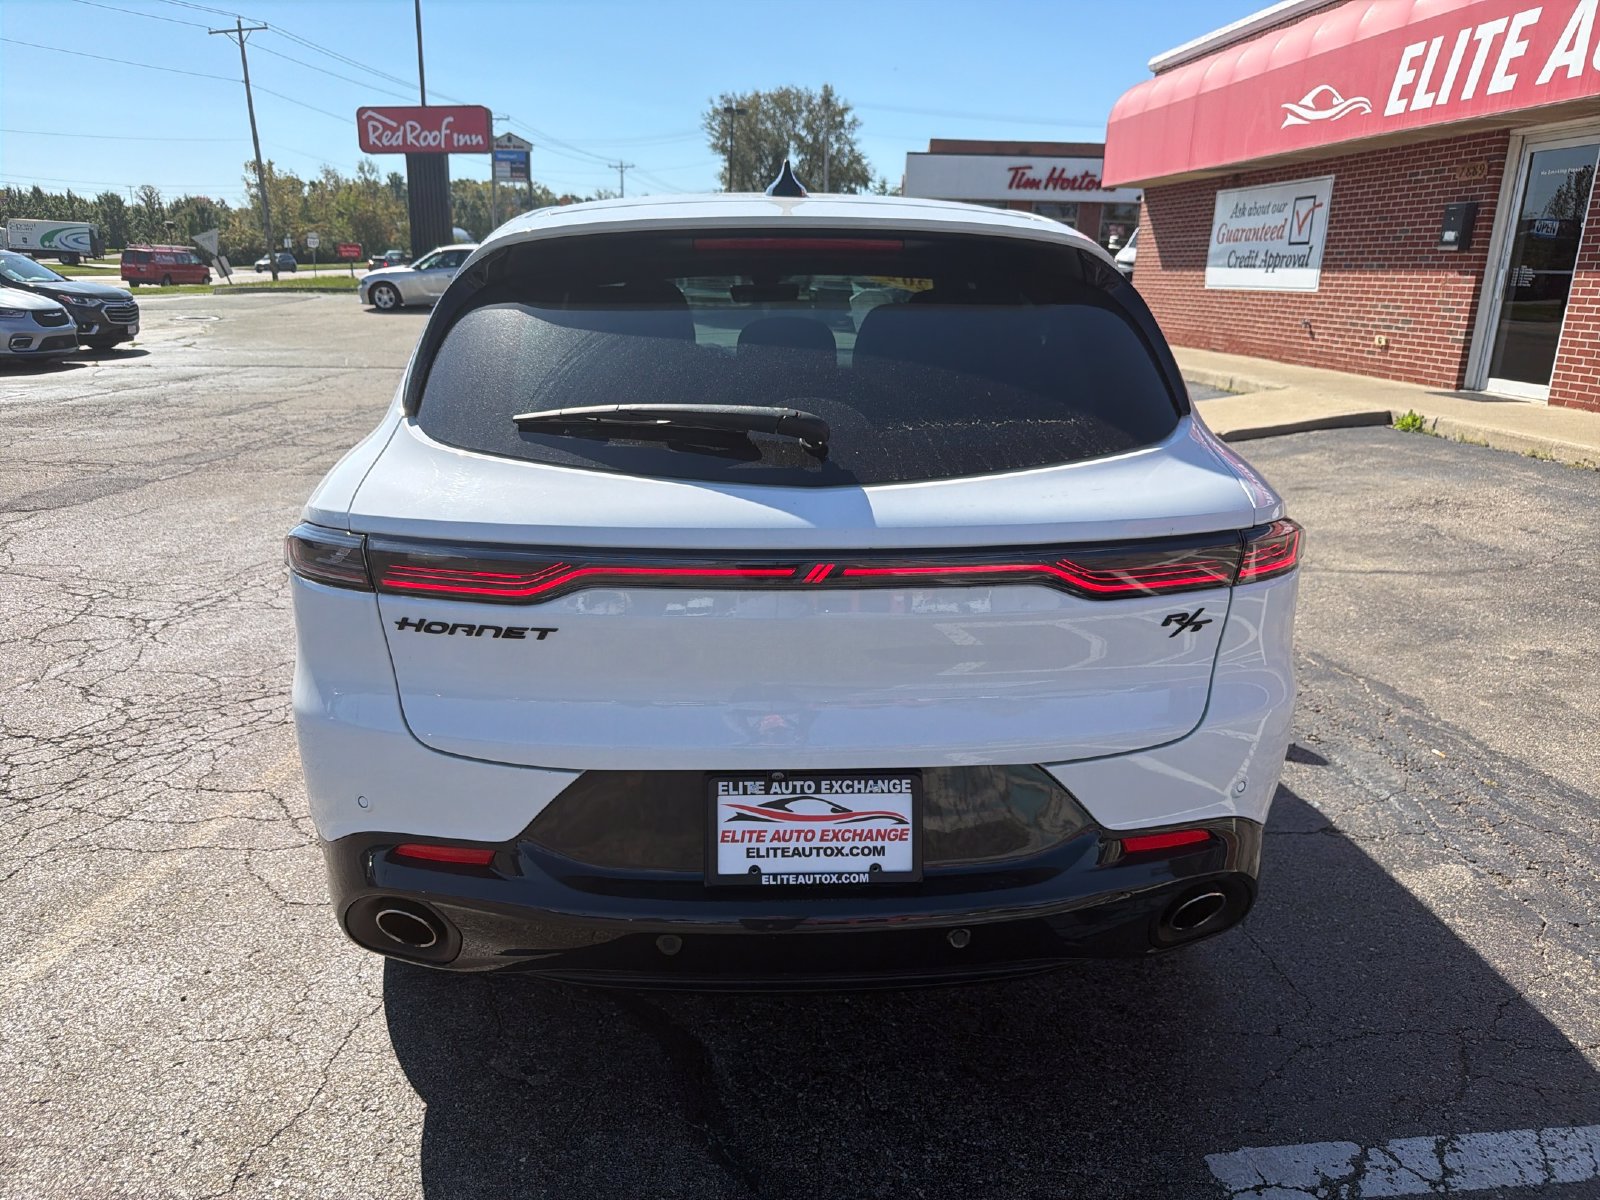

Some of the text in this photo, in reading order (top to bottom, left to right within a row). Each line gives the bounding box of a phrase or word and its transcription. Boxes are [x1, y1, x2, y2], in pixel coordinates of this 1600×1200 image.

[1383, 0, 1600, 117] ELITE A
[367, 119, 404, 147] Red
[405, 117, 454, 149] Roof
[1007, 165, 1042, 190] Tim
[1229, 200, 1288, 219] Ask about our
[1216, 218, 1288, 245] Guaranteed
[1536, 222, 1557, 234] OPEN
[1227, 245, 1314, 273] Credit Approval
[394, 616, 559, 641] HORNET
[1160, 607, 1213, 638] R/T
[717, 779, 912, 796] ELITE AUTO EXCHANGE
[719, 827, 911, 844] ELITE AUTO EXCHANGE
[745, 845, 886, 859] ELITEAUTOX.COM
[761, 873, 870, 885] ELITEAUTOX.COM
